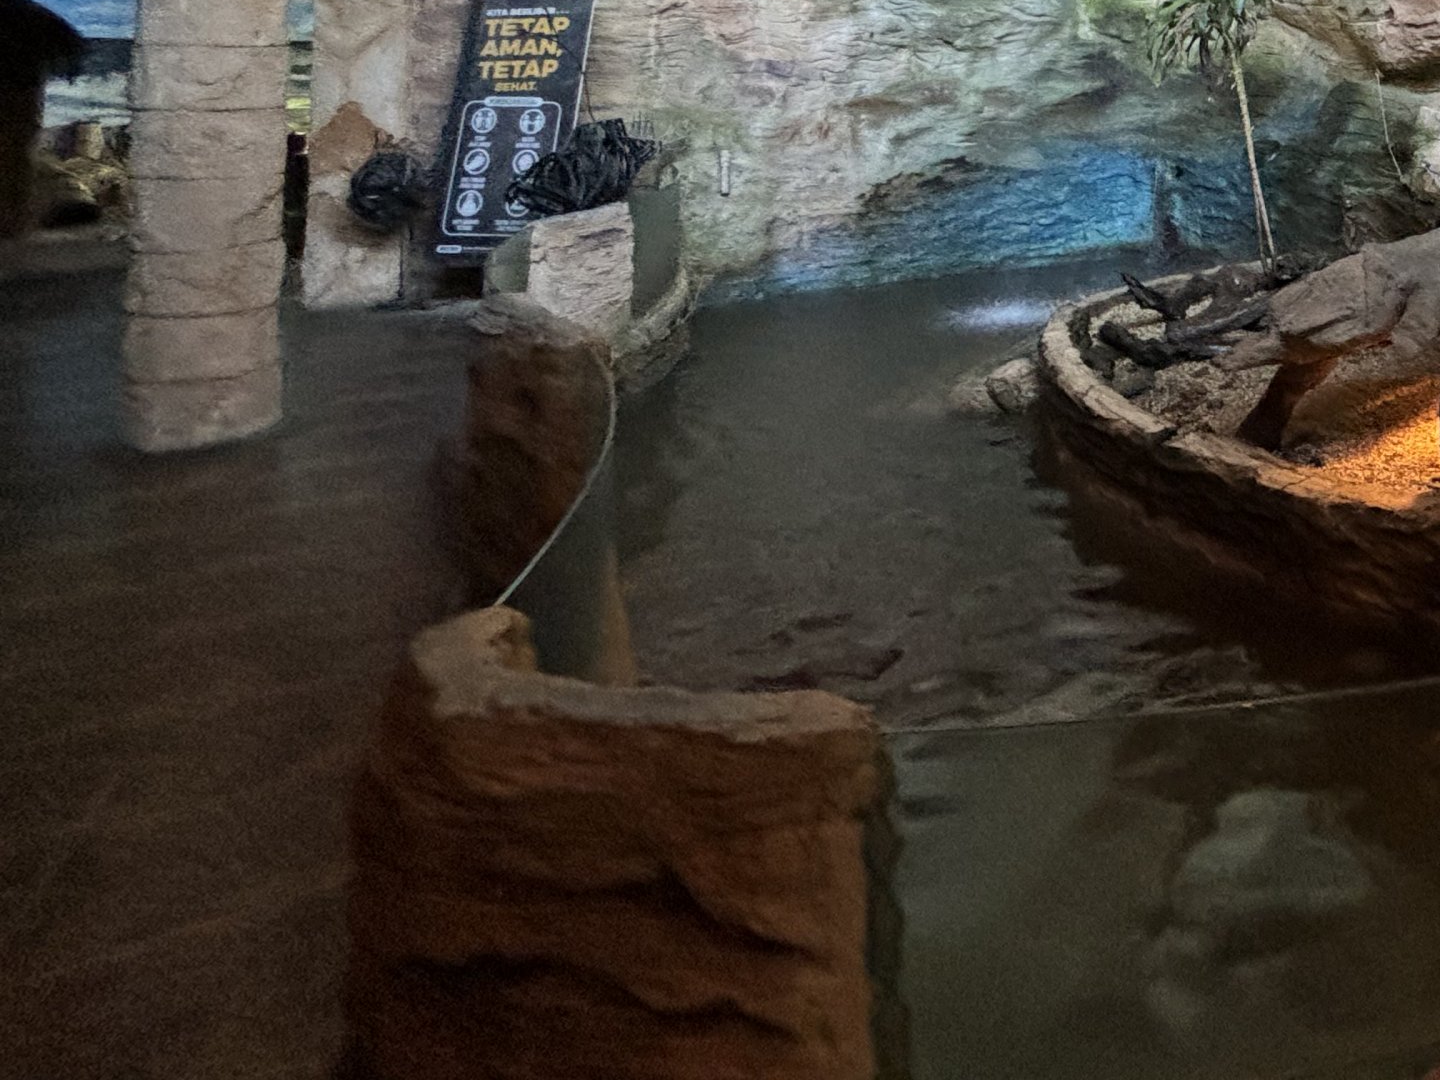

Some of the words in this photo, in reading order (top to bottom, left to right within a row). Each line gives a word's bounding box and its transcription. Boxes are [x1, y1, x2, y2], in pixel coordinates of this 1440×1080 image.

[485, 16, 571, 37] TETAP
[480, 38, 563, 57] AMAN,
[478, 59, 559, 80] TETAP
